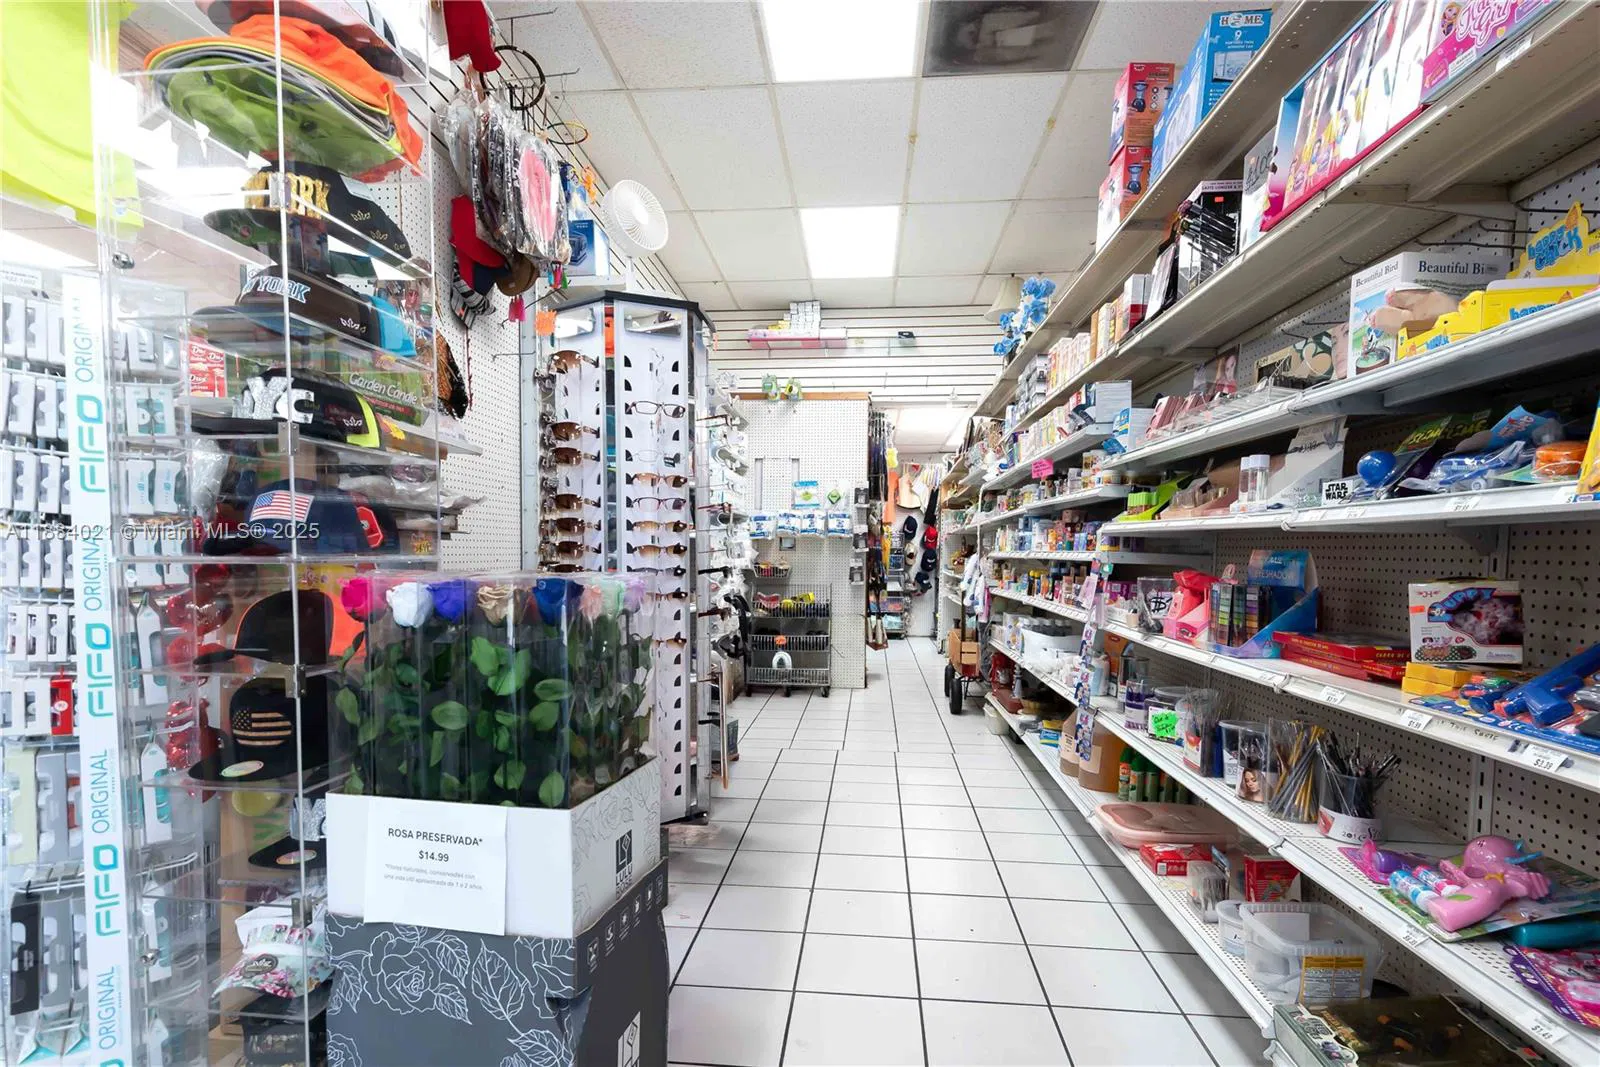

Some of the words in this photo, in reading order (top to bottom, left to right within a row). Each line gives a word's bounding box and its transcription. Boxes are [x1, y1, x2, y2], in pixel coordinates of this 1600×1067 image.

[1355, 267, 1384, 288] Beautiful
[1384, 262, 1398, 275] Bird
[1418, 260, 1469, 275] Beautiful
[349, 372, 386, 394] Garden
[386, 382, 418, 404] Candle
[77, 393, 106, 493] FIFO
[1325, 483, 1348, 492] STAR
[1325, 491, 1348, 501] WARS
[84, 623, 113, 718] FIFO
[91, 749, 111, 834] ORIGINAL
[388, 827, 413, 839] ROSA
[418, 850, 449, 862] $14.99
[616, 863, 632, 886] LULU
[93, 844, 121, 937] FIFO
[96, 965, 116, 1050] ORIGINAL
